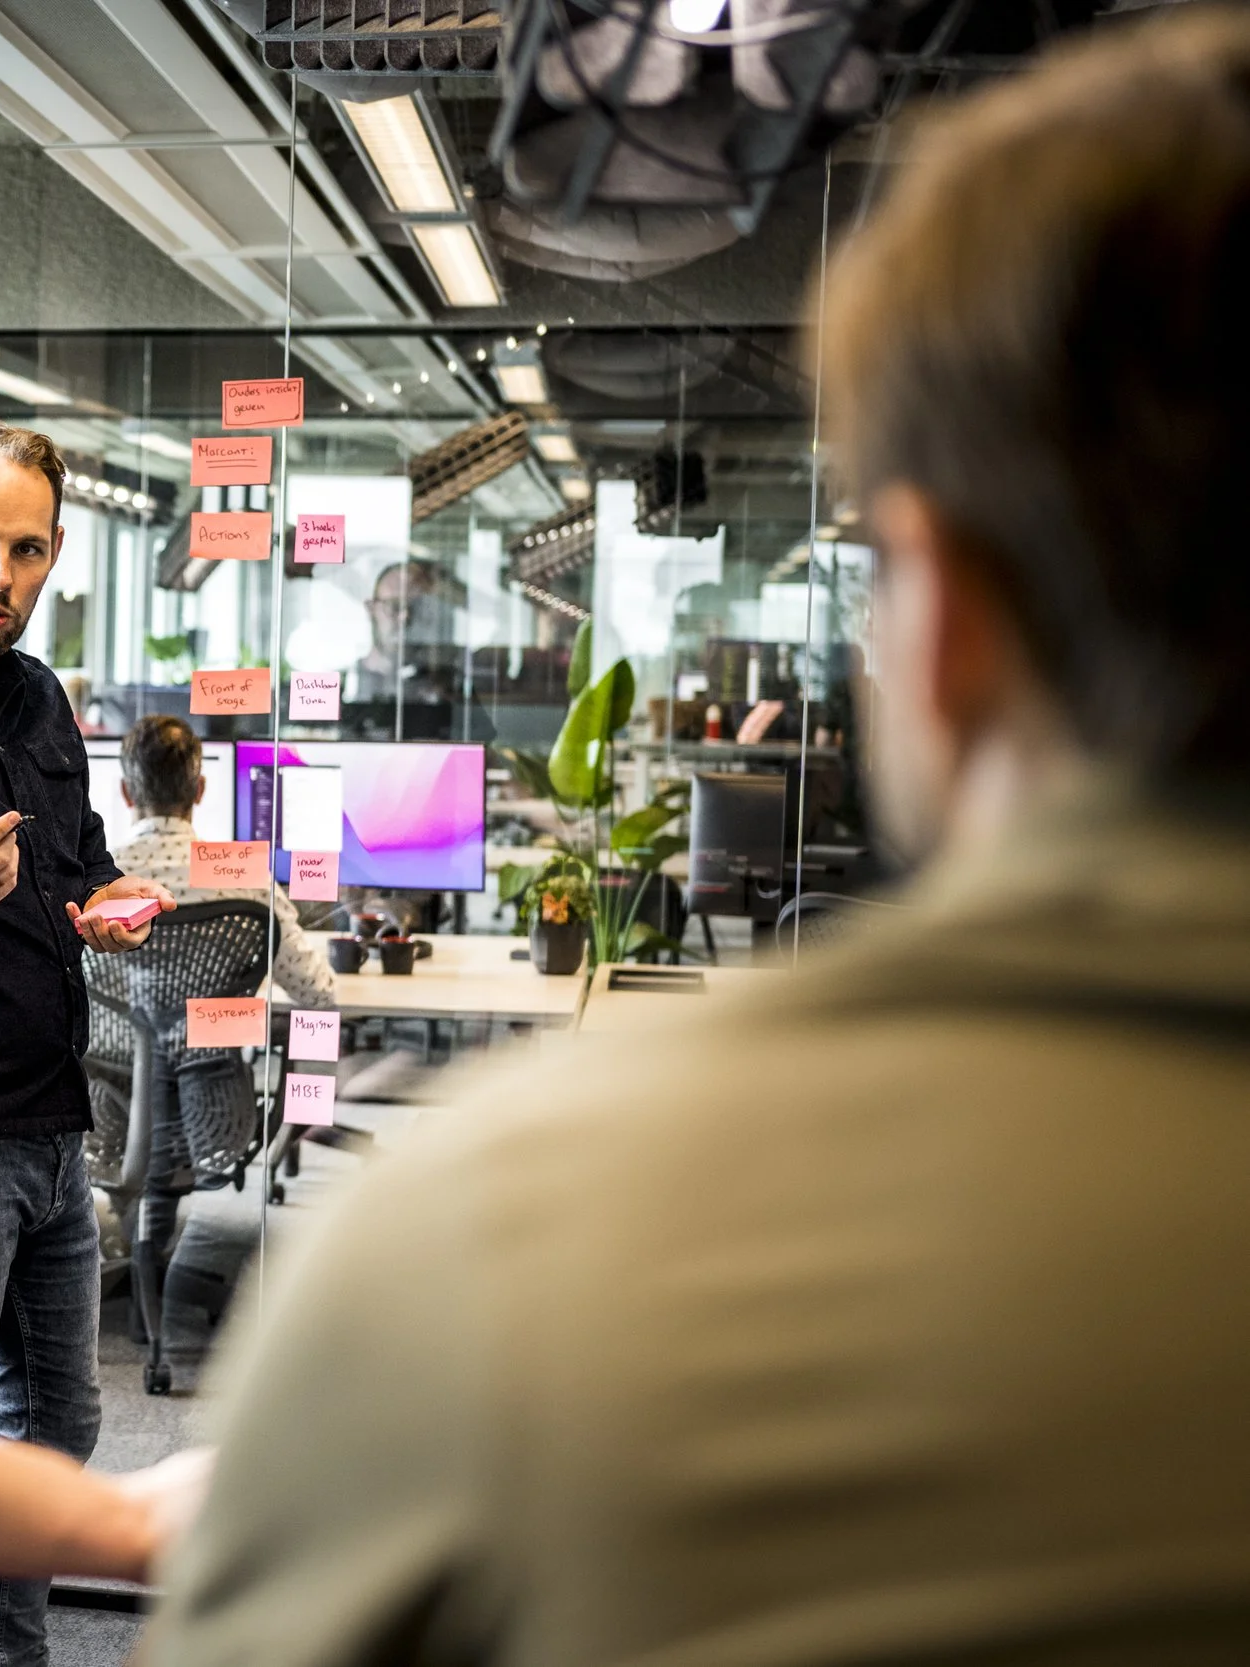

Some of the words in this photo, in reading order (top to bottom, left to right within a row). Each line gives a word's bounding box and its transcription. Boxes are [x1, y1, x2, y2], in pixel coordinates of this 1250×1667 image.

[199, 526, 250, 542] Actions
[302, 522, 309, 532] 3
[200, 678, 235, 696] Front
[240, 678, 253, 692] of
[197, 845, 231, 861] Back
[238, 846, 253, 859] of
[195, 1007, 257, 1023] Systems
[291, 1084, 322, 1099] MBE
